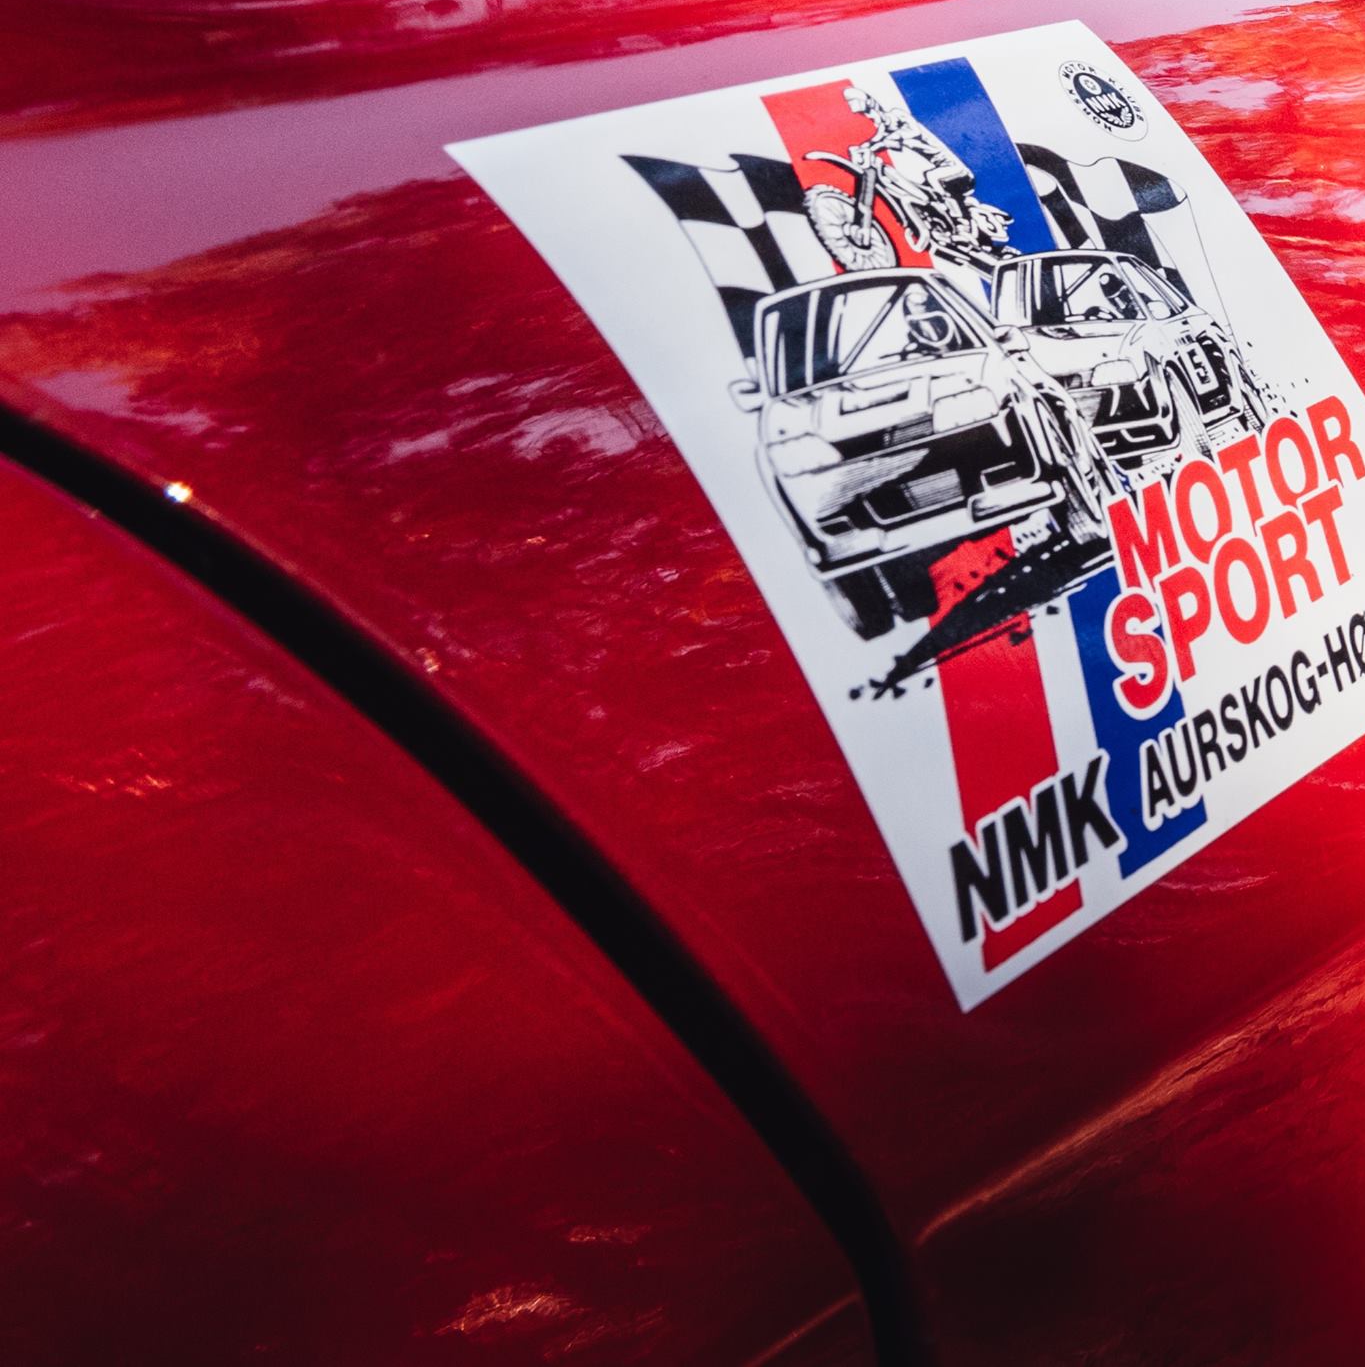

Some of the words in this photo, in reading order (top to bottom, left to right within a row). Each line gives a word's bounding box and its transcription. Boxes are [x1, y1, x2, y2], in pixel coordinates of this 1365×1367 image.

[1084, 92, 1127, 113] NMK
[1187, 348, 1210, 385] 5
[1111, 484, 1352, 709] SPORT
[949, 754, 1120, 944] NMK
